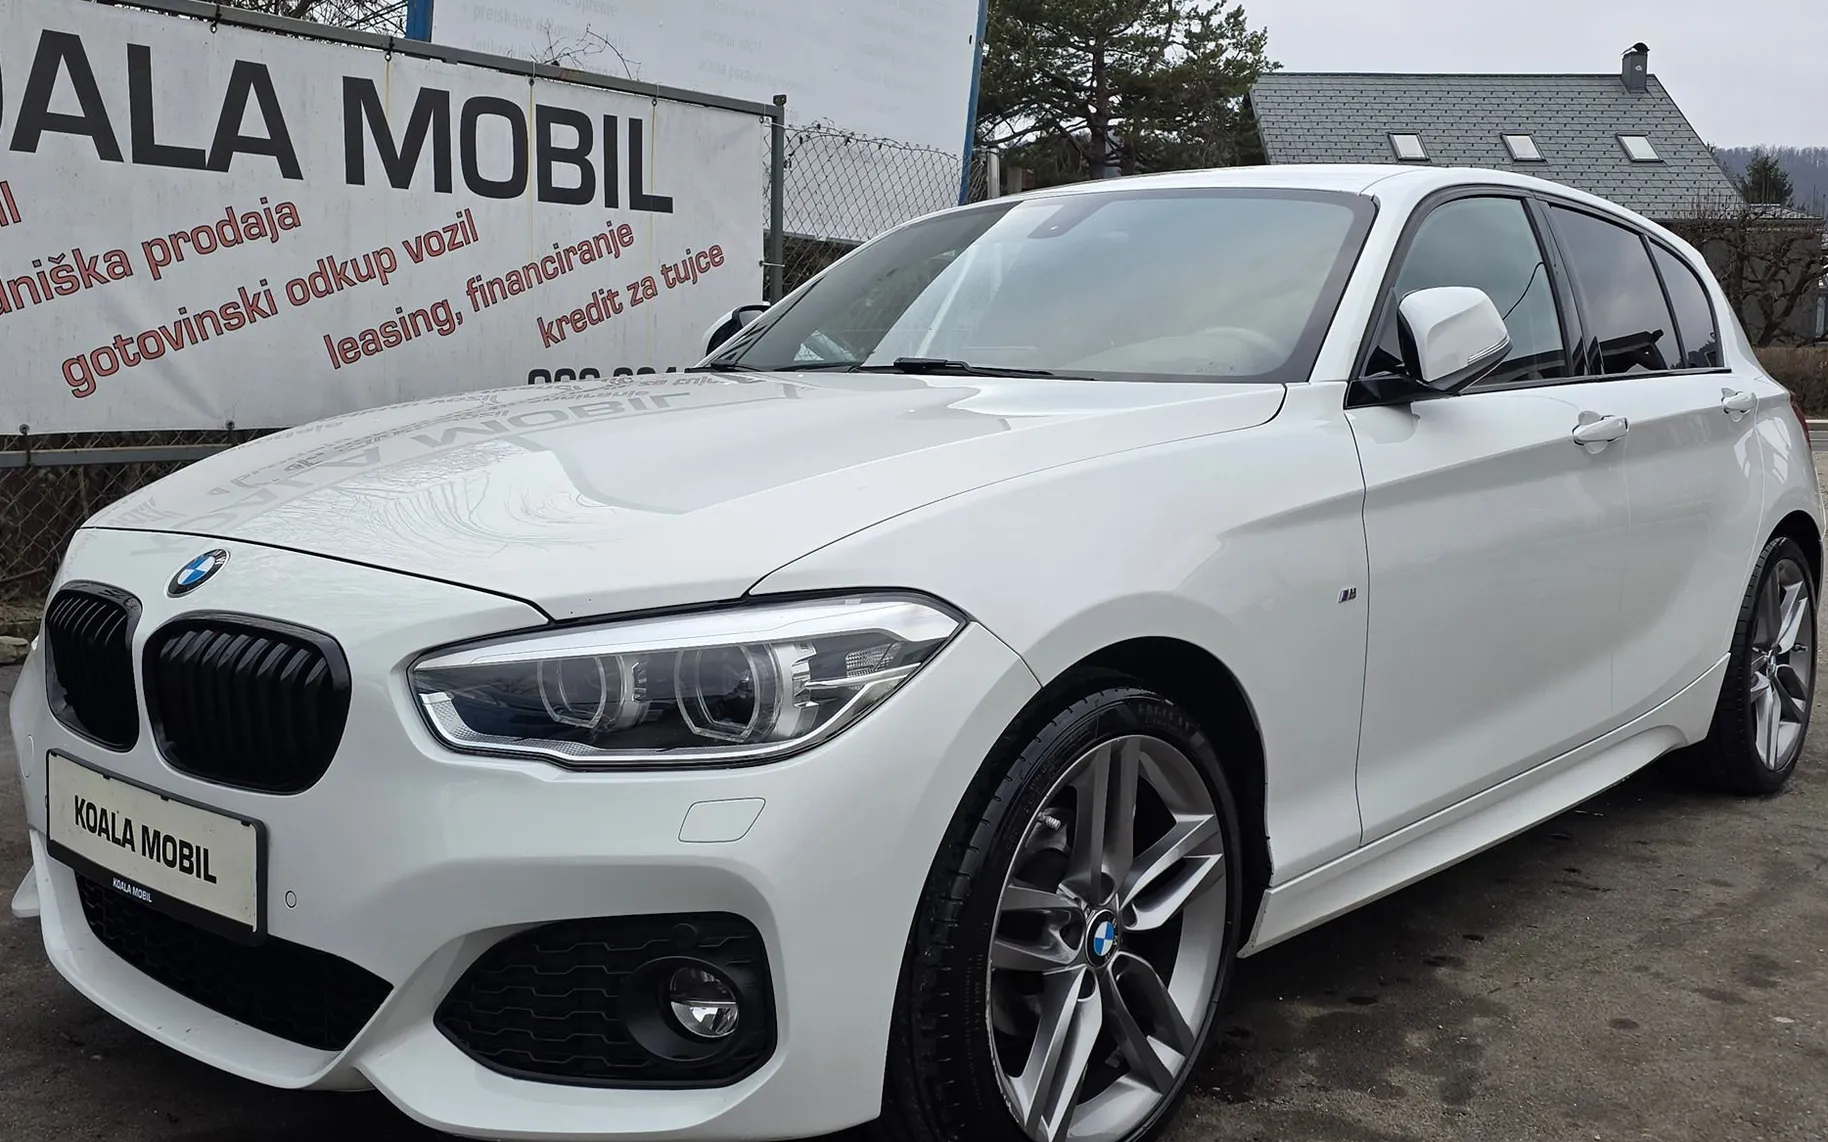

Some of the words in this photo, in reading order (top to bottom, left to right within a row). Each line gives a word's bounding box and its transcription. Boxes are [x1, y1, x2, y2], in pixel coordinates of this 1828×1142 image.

[0, 29, 303, 180] ALA
[342, 75, 674, 214] MOBIL
[141, 197, 302, 281] prodaja
[61, 279, 278, 398] gotovinski
[285, 246, 398, 307] odkup
[402, 208, 480, 264] vozil
[323, 298, 464, 370] leasing,
[466, 220, 635, 312] financiranje
[537, 288, 624, 349] kredit
[627, 273, 659, 307] za
[661, 244, 726, 293] tujce
[74, 795, 136, 852] KOALA
[141, 824, 218, 884] MOBIL
[112, 877, 132, 894] KOALA
[132, 886, 153, 903] MOBIL
